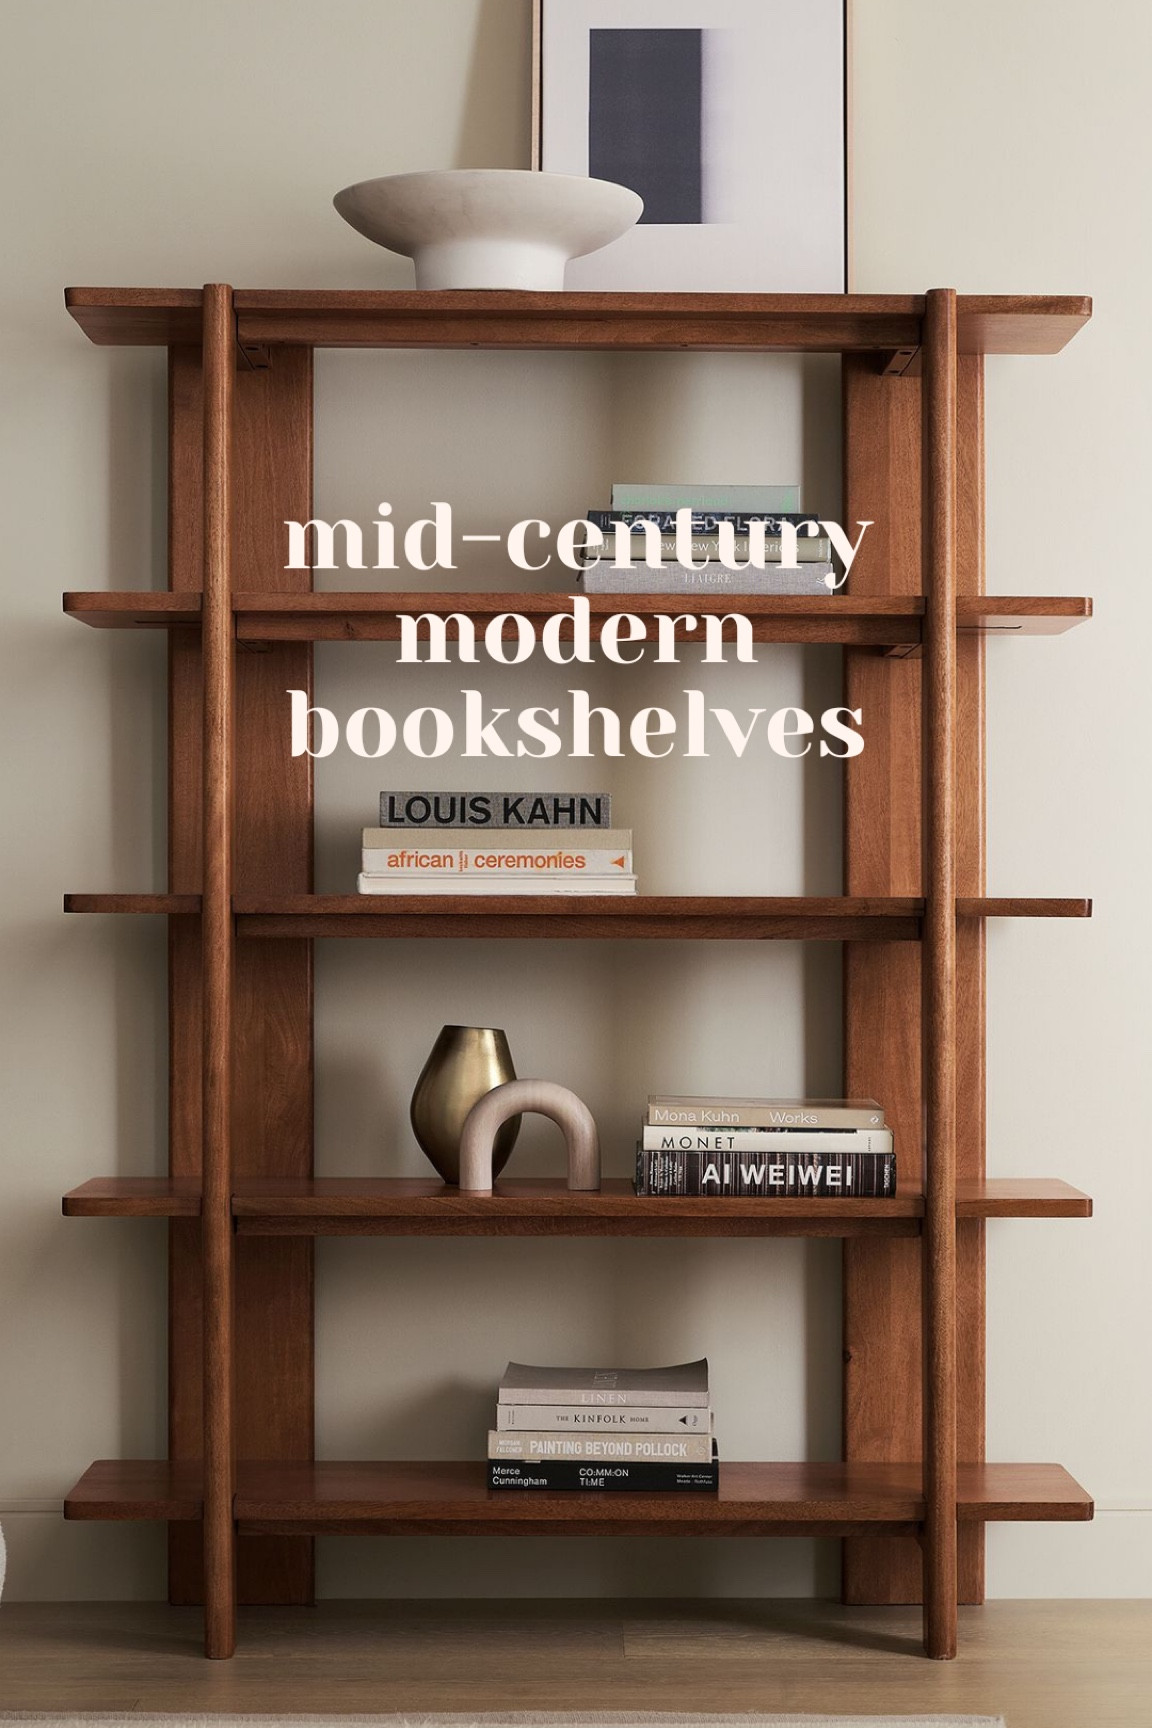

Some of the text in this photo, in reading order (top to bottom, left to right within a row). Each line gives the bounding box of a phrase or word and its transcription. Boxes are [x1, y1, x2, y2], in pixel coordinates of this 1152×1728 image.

[621, 514, 716, 531] FORAED
[711, 541, 740, 552] Yk
[743, 541, 800, 553] Ieris
[387, 796, 602, 825] LOUIS KAHN
[387, 851, 454, 868] african
[474, 852, 586, 869] ceremonies
[654, 1110, 818, 1124] Mona Kuhn Works
[661, 1136, 735, 1149] MONET
[702, 1163, 730, 1184] AI
[740, 1165, 852, 1186] WEIWEI
[581, 1393, 627, 1403] LINEN
[574, 1414, 626, 1423] KINFOLK
[530, 1441, 687, 1457] PAINTING BEYOND POLLOCK
[492, 1467, 520, 1475] Merce
[492, 1476, 547, 1487] Cunningham
